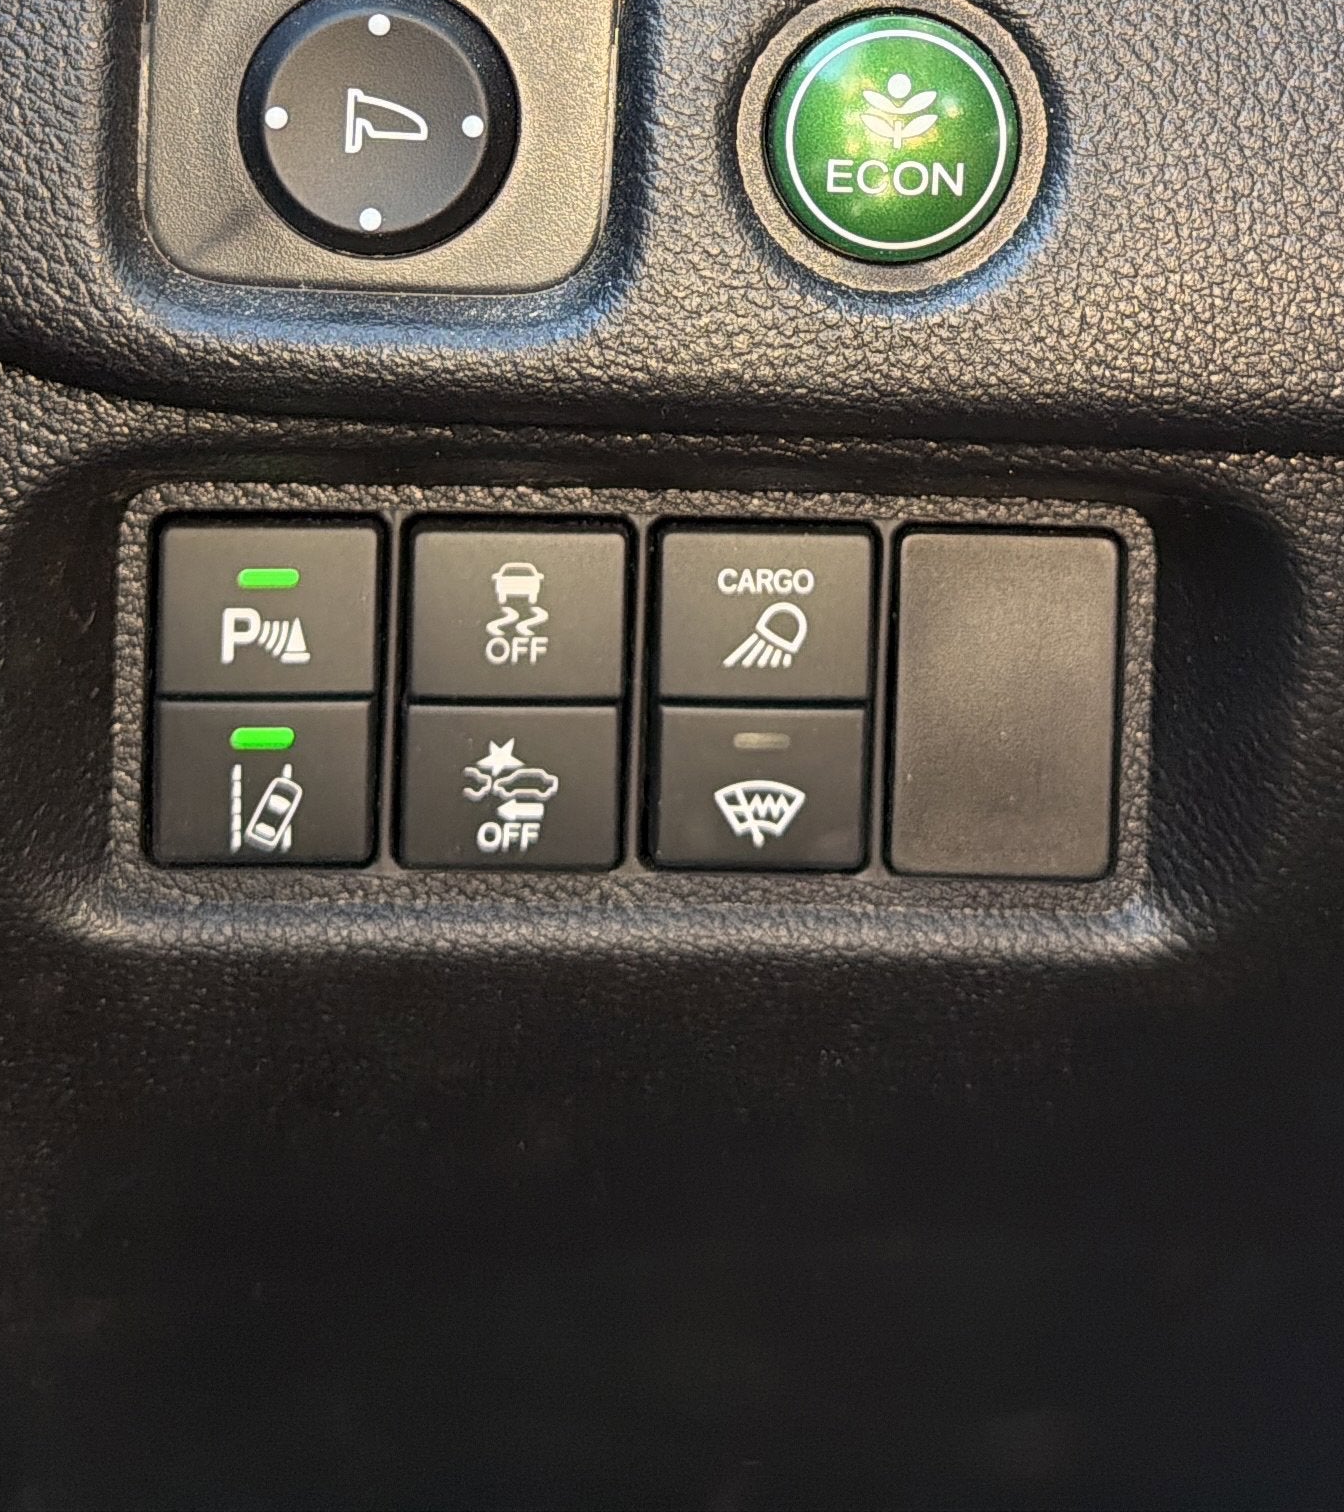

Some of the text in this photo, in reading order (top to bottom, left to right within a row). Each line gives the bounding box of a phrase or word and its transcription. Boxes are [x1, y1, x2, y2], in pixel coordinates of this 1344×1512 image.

[826, 158, 965, 197] ECON
[717, 568, 815, 595] CARGO
[485, 636, 548, 664] OFF
[476, 822, 540, 851] OFF
